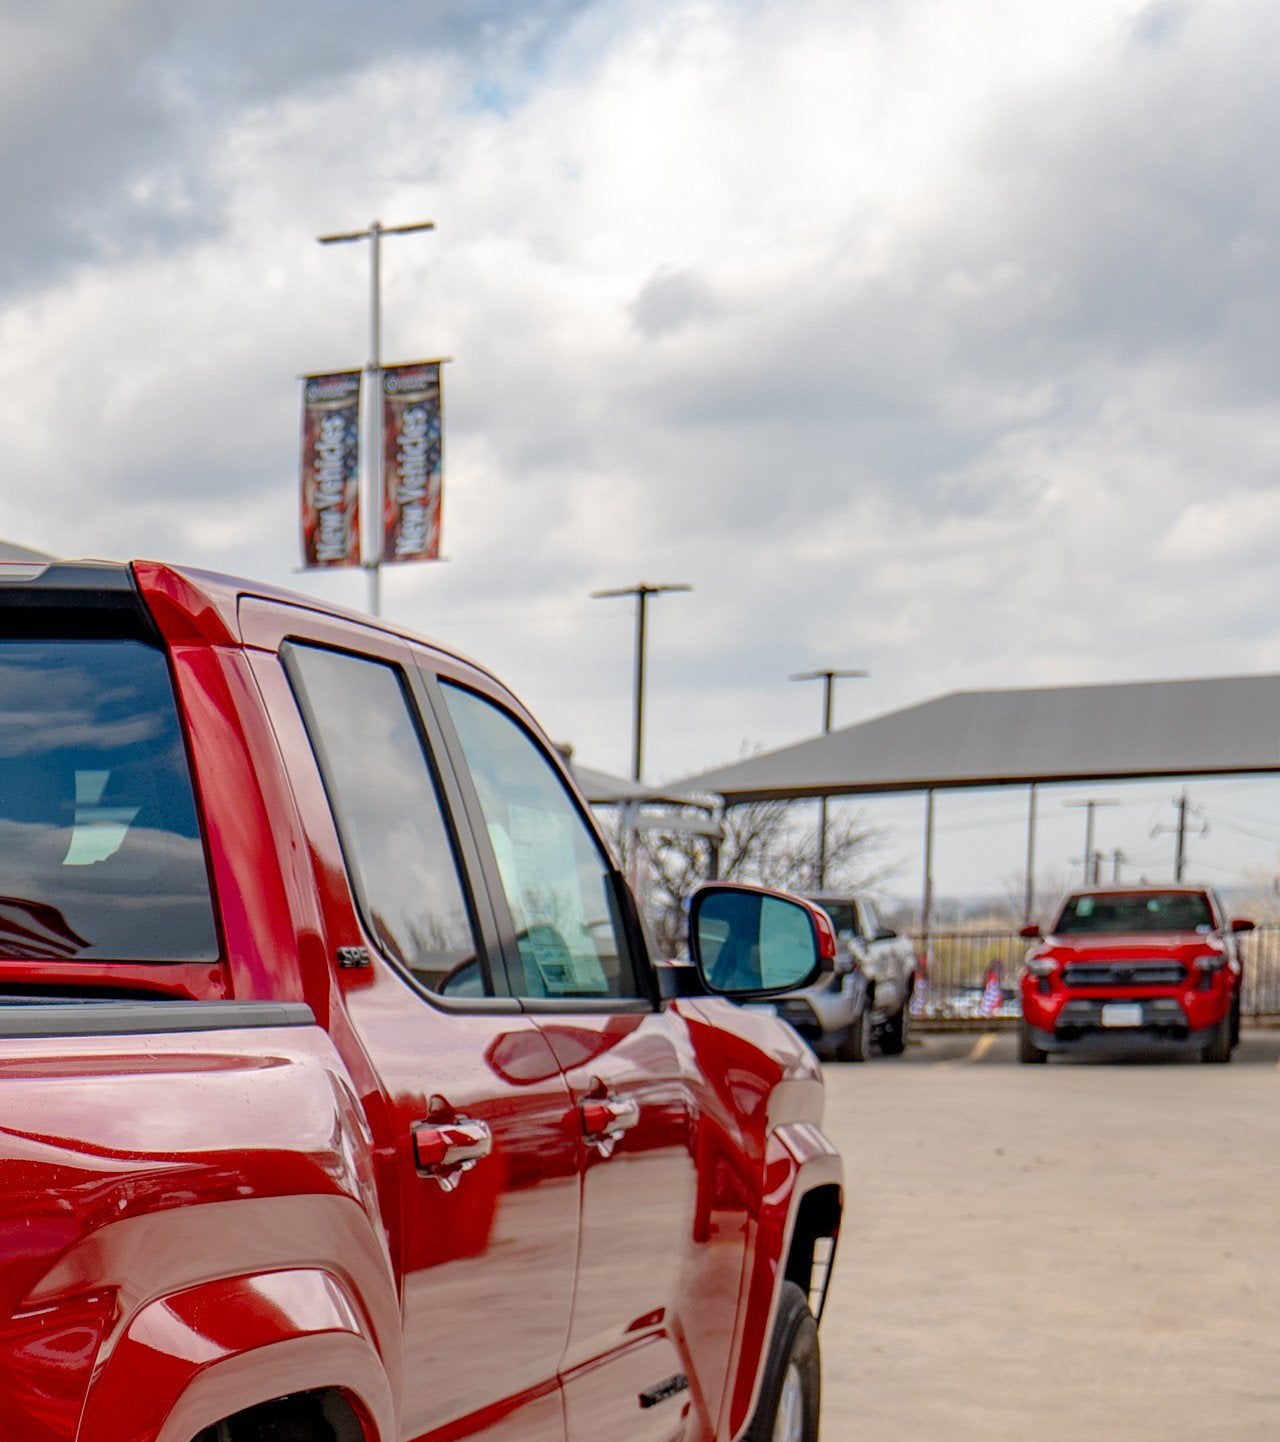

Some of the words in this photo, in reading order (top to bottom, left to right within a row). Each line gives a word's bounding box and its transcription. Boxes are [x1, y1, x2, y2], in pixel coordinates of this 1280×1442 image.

[313, 415, 346, 510] Vehicles
[396, 408, 428, 505] Vehicles
[316, 511, 346, 561] New
[395, 505, 427, 556] New
